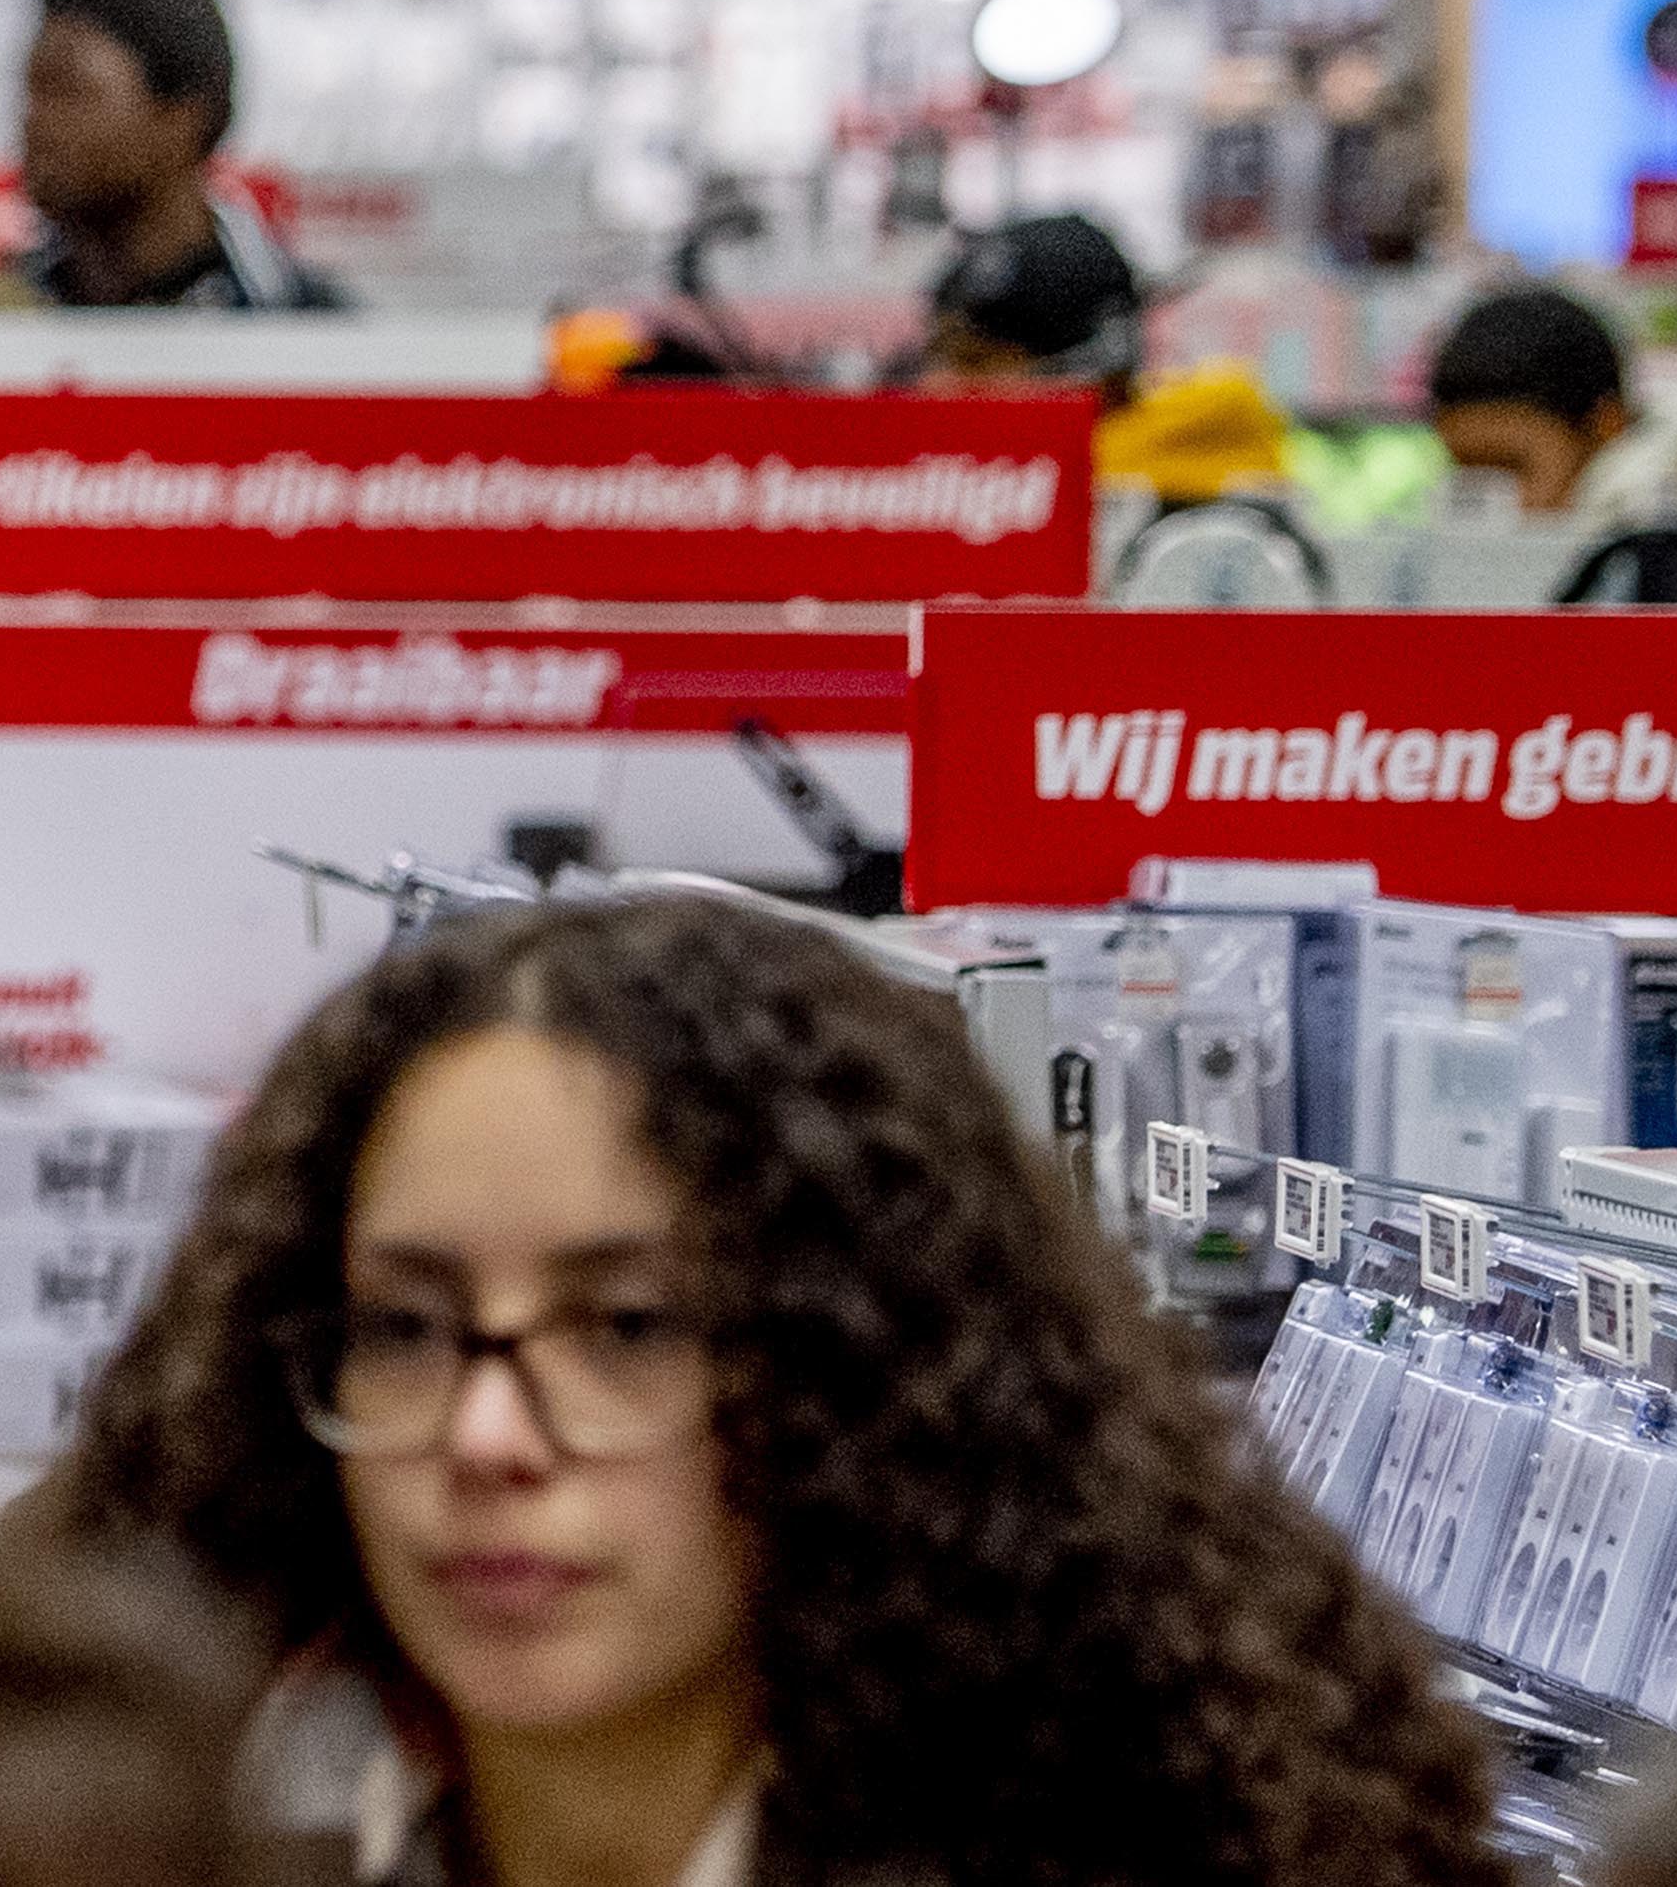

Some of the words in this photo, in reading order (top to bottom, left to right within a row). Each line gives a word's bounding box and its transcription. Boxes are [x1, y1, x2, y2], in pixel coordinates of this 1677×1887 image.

[230, 450, 350, 539] zijn
[353, 452, 747, 531] elektronisch
[190, 630, 623, 724] Draaibaar
[1034, 709, 1185, 818] Wij
[1187, 713, 1497, 805] maken
